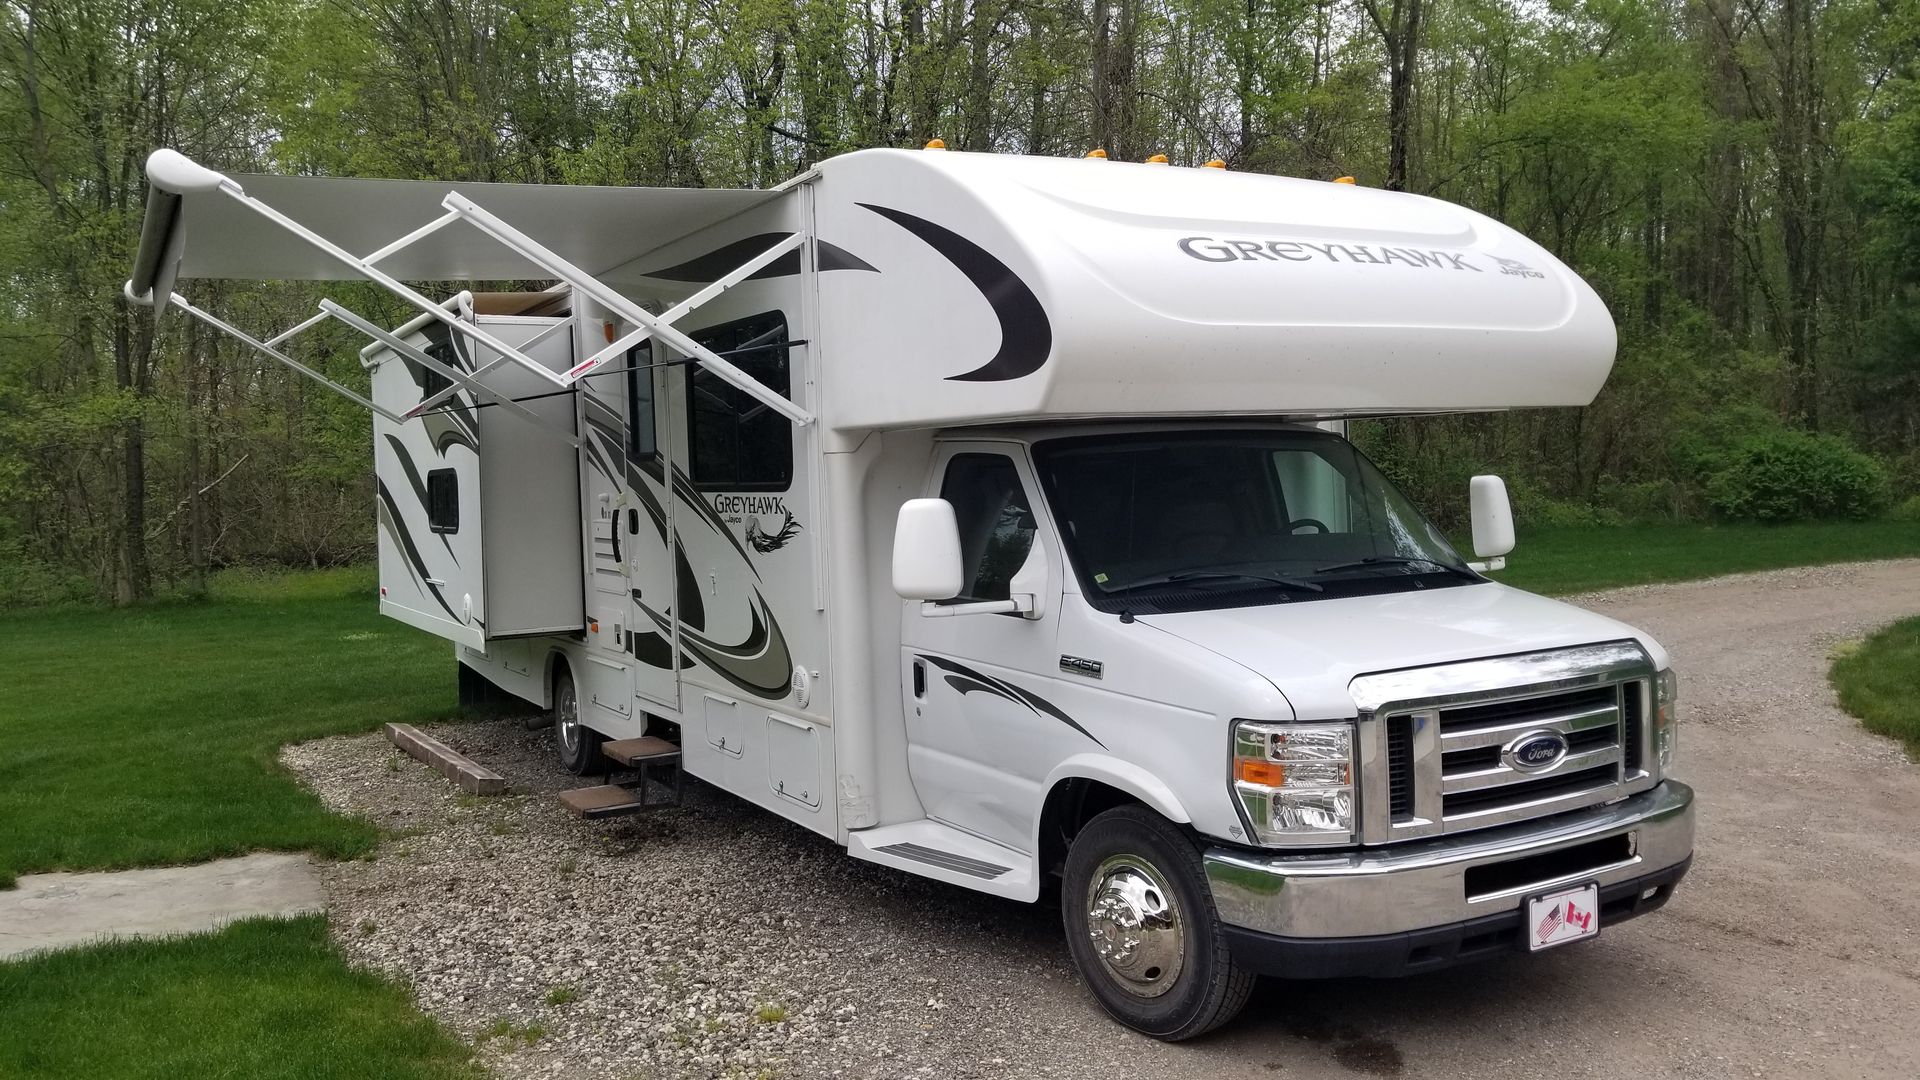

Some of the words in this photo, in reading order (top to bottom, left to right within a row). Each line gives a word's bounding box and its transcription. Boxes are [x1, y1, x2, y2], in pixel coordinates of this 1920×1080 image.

[1177, 237, 1483, 272] GREYHAWK
[1500, 266, 1545, 278] Jayco
[714, 494, 784, 515] GREYHAWK
[1528, 741, 1556, 761] Ford
